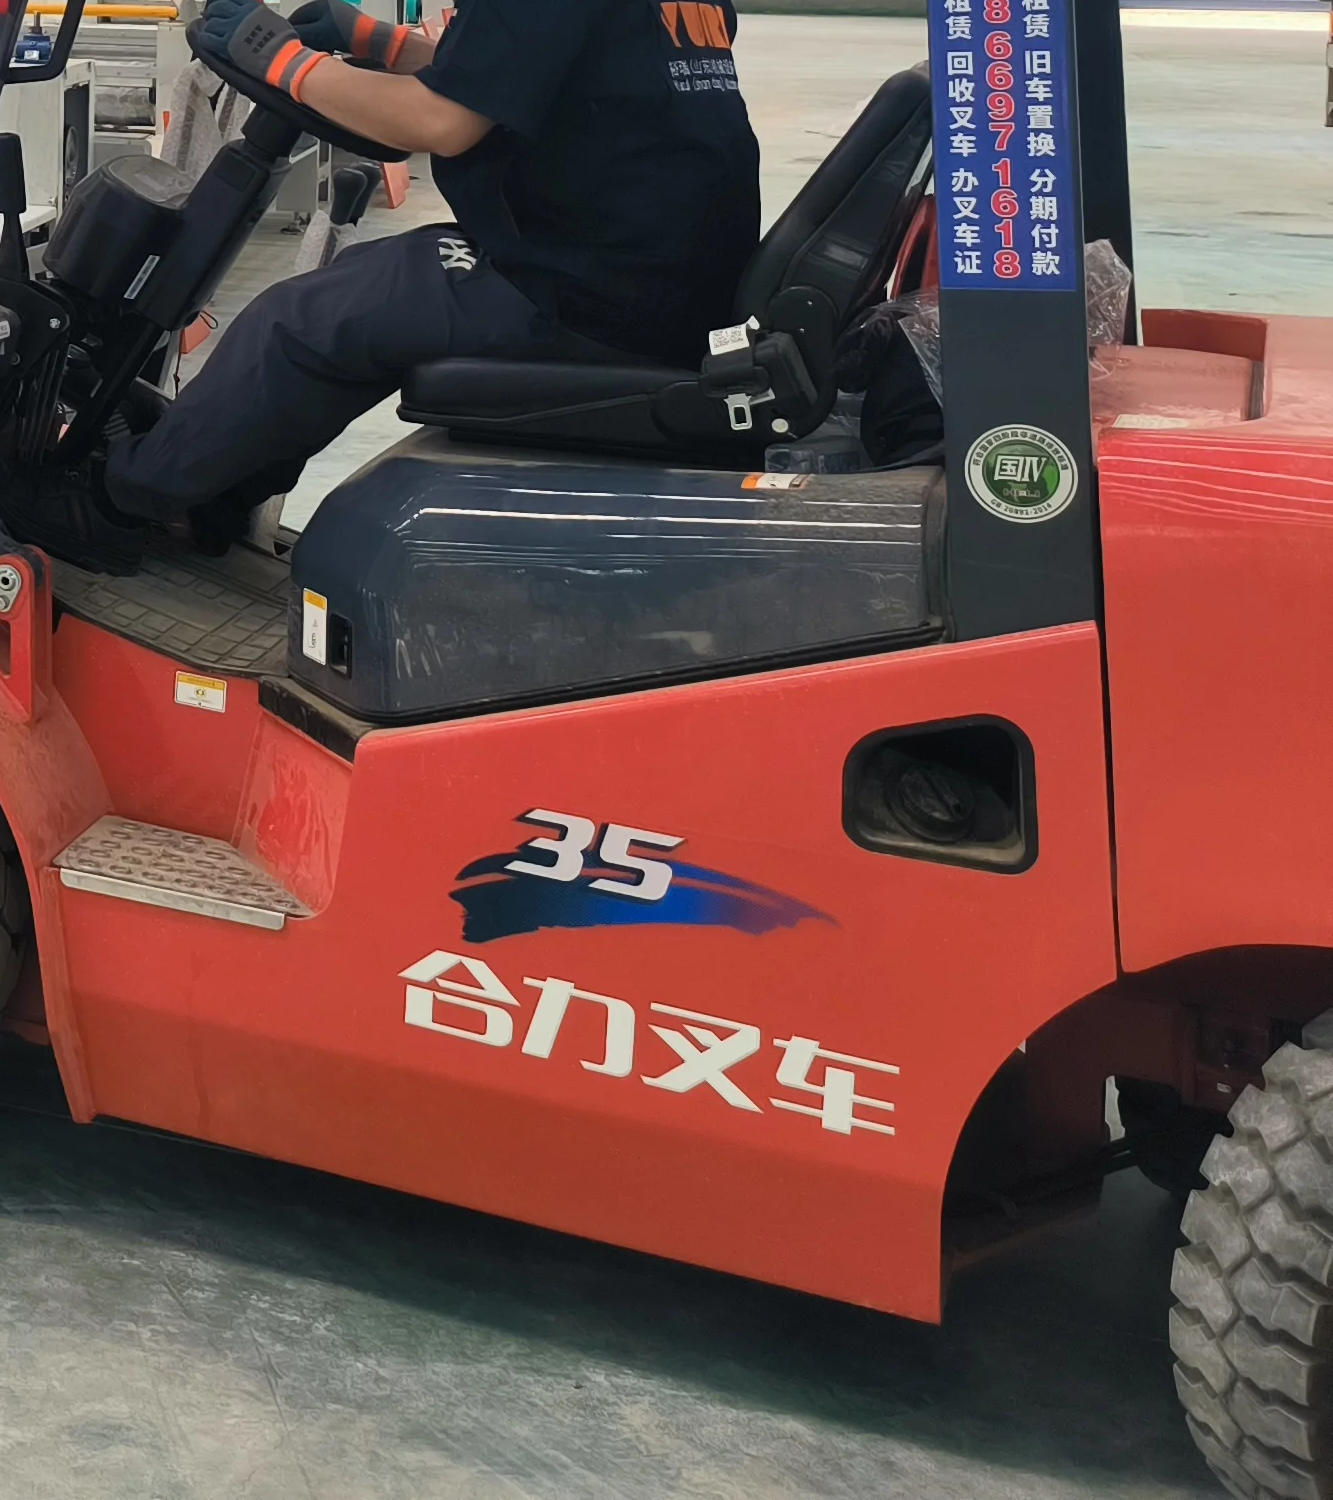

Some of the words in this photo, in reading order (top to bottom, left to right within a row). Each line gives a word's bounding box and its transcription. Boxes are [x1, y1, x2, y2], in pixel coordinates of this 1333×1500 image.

[946, 51, 978, 158] 回收叉车
[1024, 50, 1056, 158] 旧车置换
[950, 167, 983, 275] 办叉车证
[1028, 168, 1061, 276] 分期付款
[503, 807, 686, 901] 35
[397, 949, 900, 1136] 合力叉车
